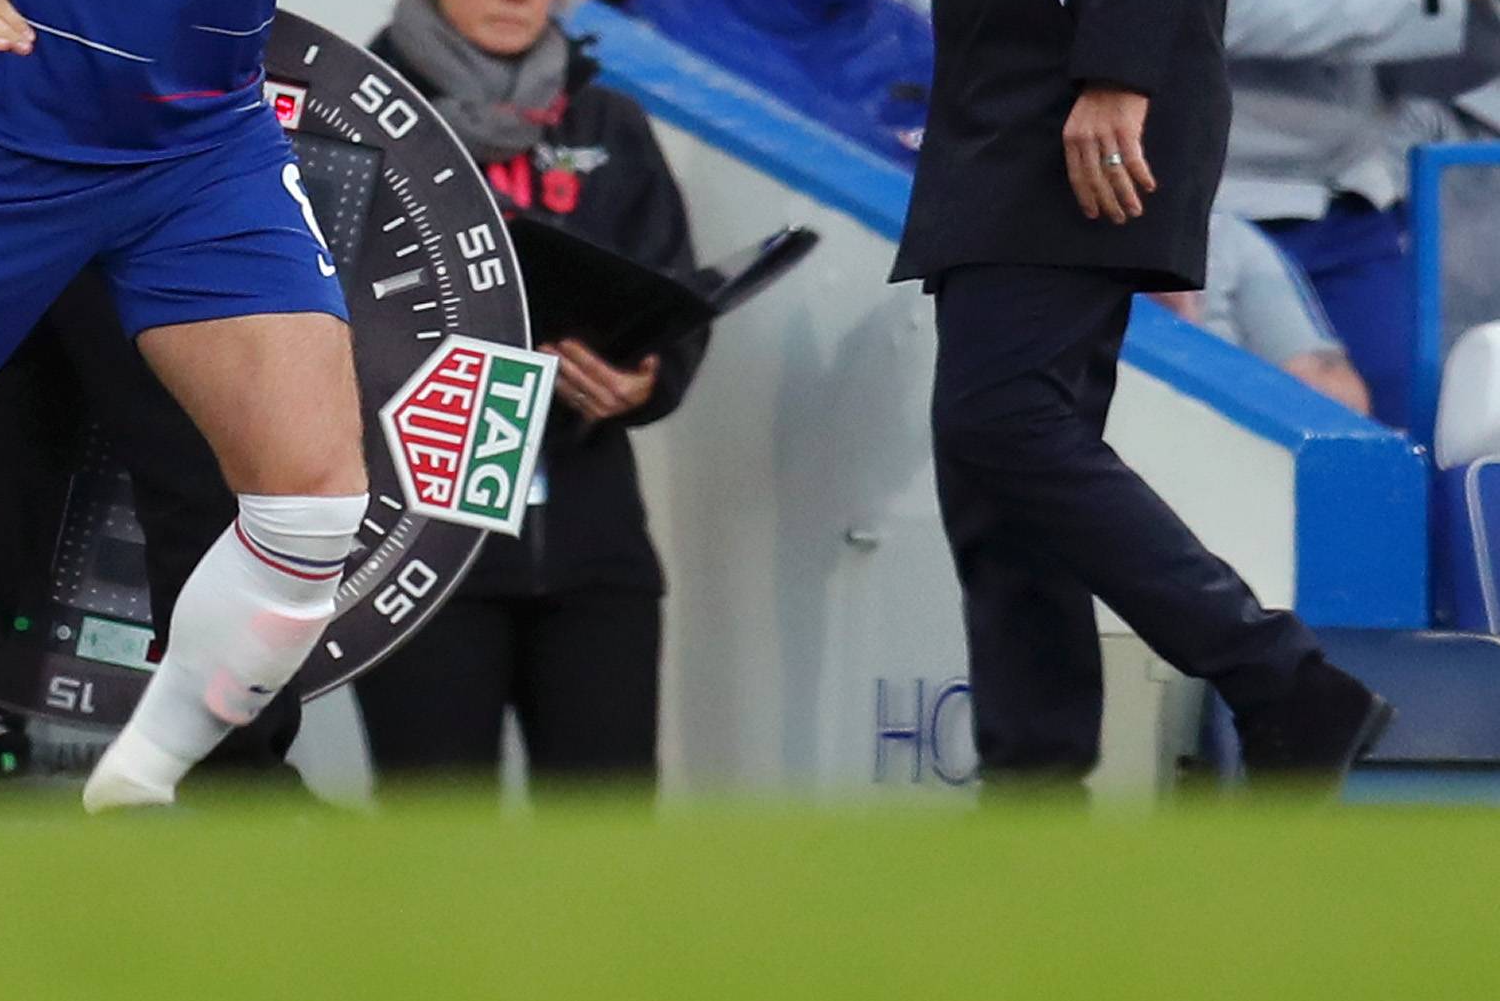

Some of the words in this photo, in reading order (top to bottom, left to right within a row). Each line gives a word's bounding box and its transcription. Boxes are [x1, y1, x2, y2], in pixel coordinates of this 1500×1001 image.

[350, 74, 419, 140] 50
[456, 224, 506, 293] 55
[398, 352, 481, 504] HEUER
[465, 371, 536, 509] TAG
[373, 559, 438, 625] 05
